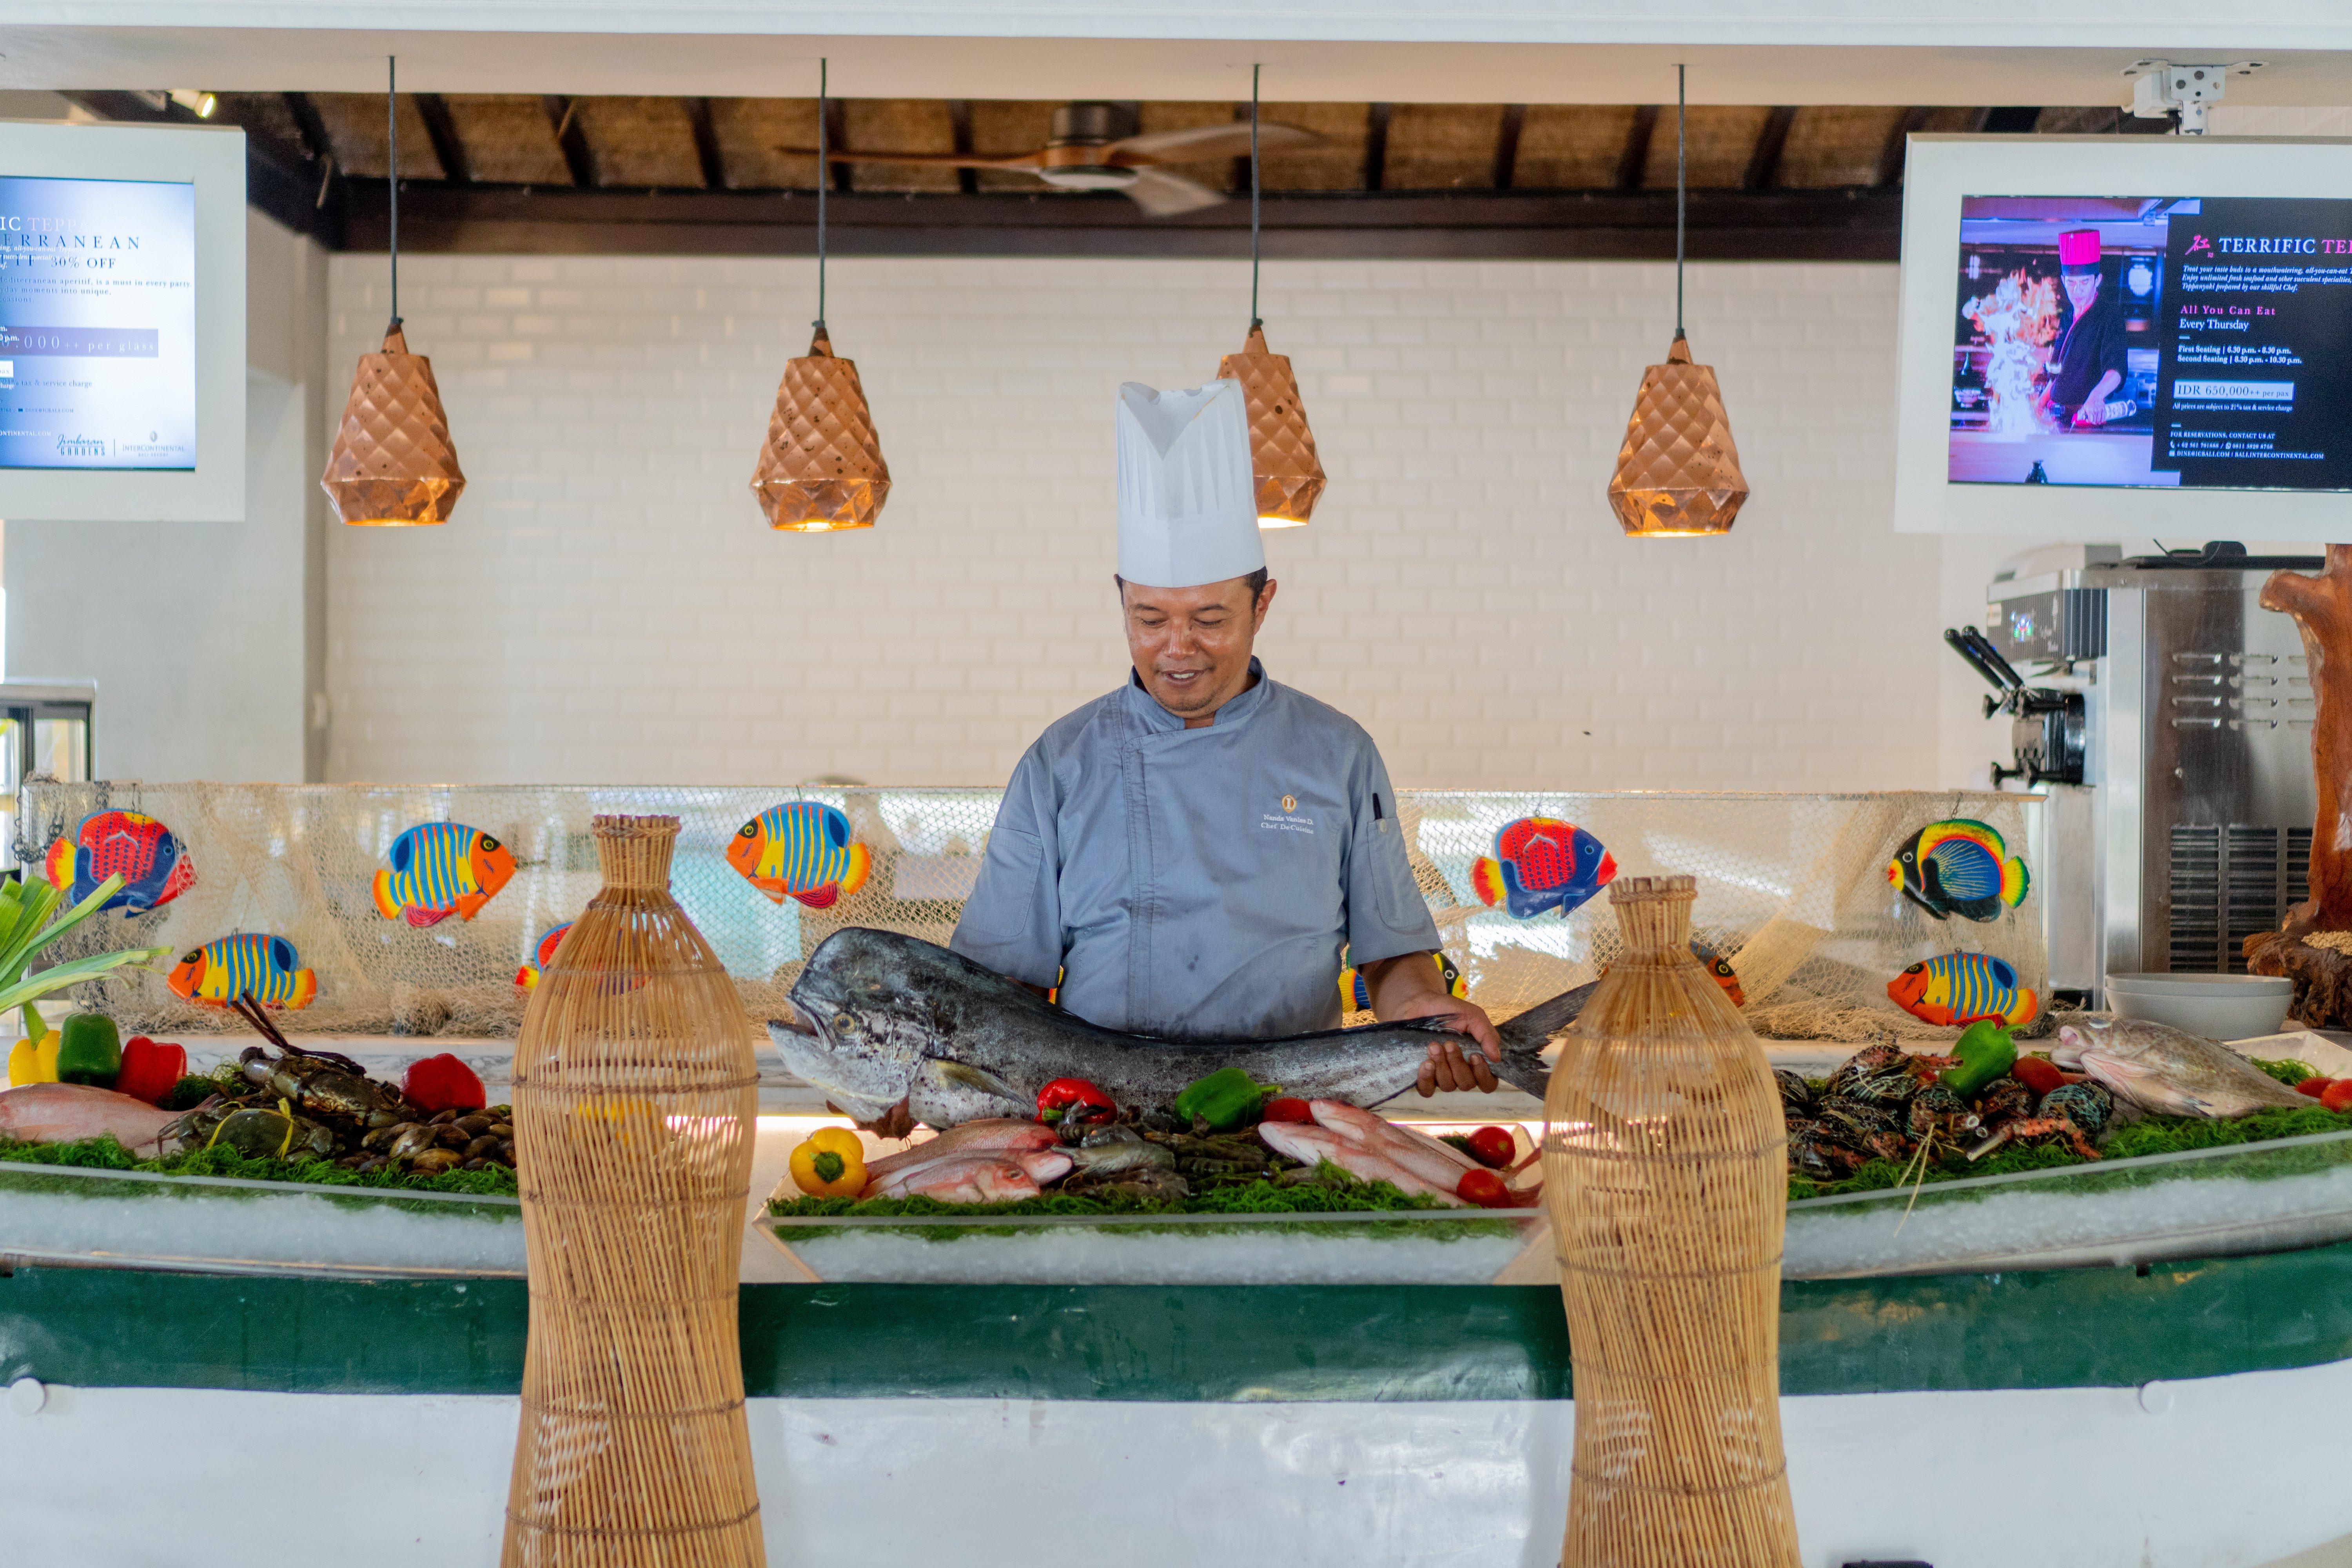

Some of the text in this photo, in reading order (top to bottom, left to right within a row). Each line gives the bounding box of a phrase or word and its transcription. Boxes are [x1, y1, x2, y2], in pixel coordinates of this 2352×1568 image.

[2218, 238, 2316, 254] TERRIFIC
[87, 257, 116, 269] OFF
[2305, 267, 2348, 276] all-you-can-eat
[2182, 274, 2199, 283] Enjoy
[2228, 274, 2242, 283] fresh
[2243, 275, 2265, 283] seafood
[2182, 283, 2215, 291] Teppanyaki
[2215, 283, 2241, 292] prepared
[2242, 283, 2248, 292] by
[2283, 284, 2298, 292] Chef.
[2180, 305, 2276, 316] All You Can Eat
[2180, 318, 2249, 332] Every Thursday
[88, 342, 111, 352] per
[119, 340, 154, 352] glass
[2178, 345, 2194, 353] First
[2196, 345, 2221, 354] Seating
[2203, 355, 2228, 364] Seating
[69, 379, 93, 389] charge
[2178, 385, 2201, 396] IDR
[2205, 385, 2259, 397] 650,000++
[2181, 403, 2196, 411] prices
